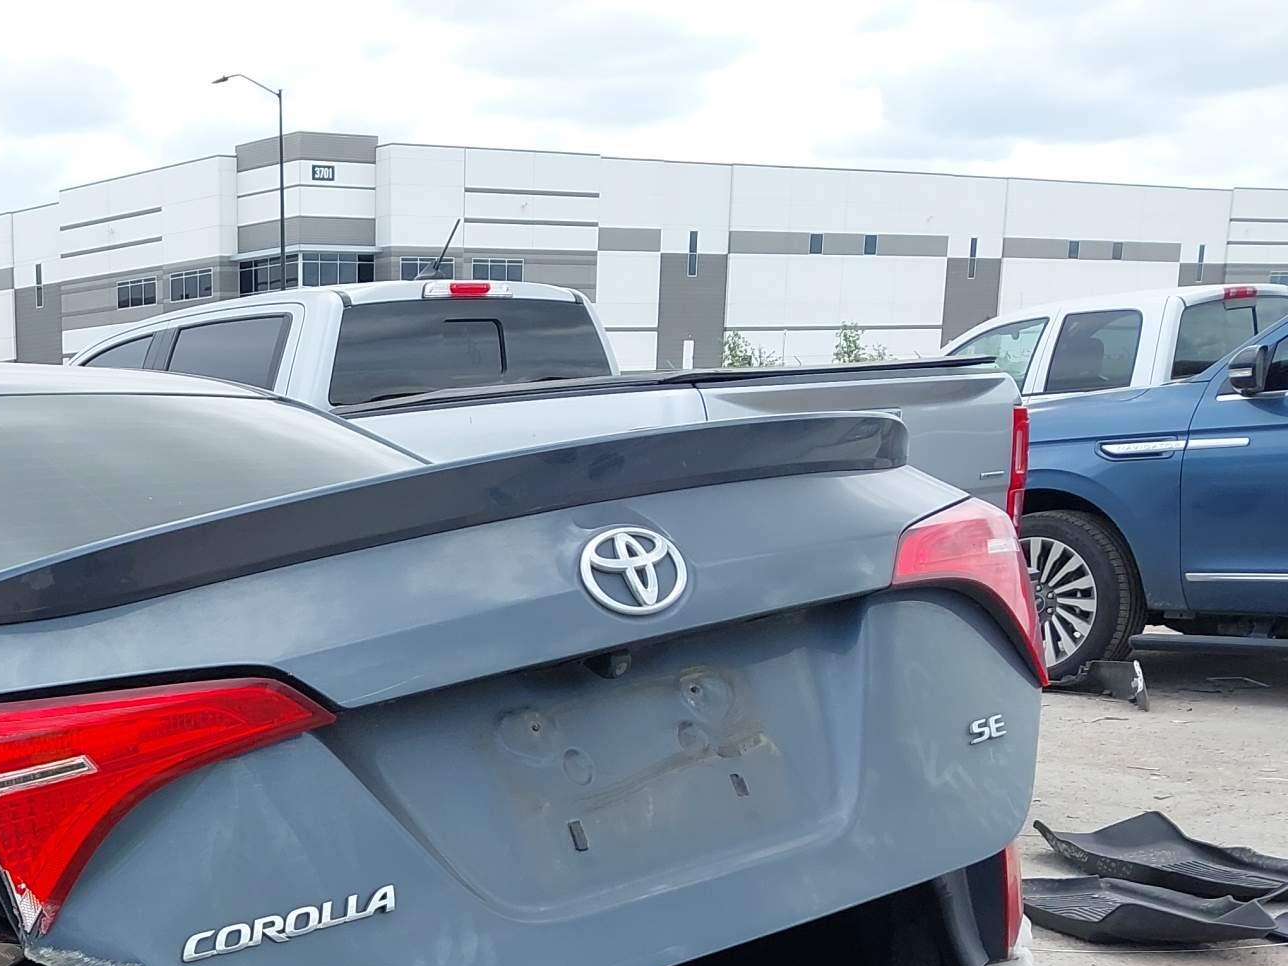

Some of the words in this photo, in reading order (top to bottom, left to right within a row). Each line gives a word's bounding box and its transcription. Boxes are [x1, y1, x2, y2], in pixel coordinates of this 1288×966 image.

[314, 167, 333, 179] 3701
[968, 713, 1008, 745] SE
[181, 882, 398, 963] COROLLA
